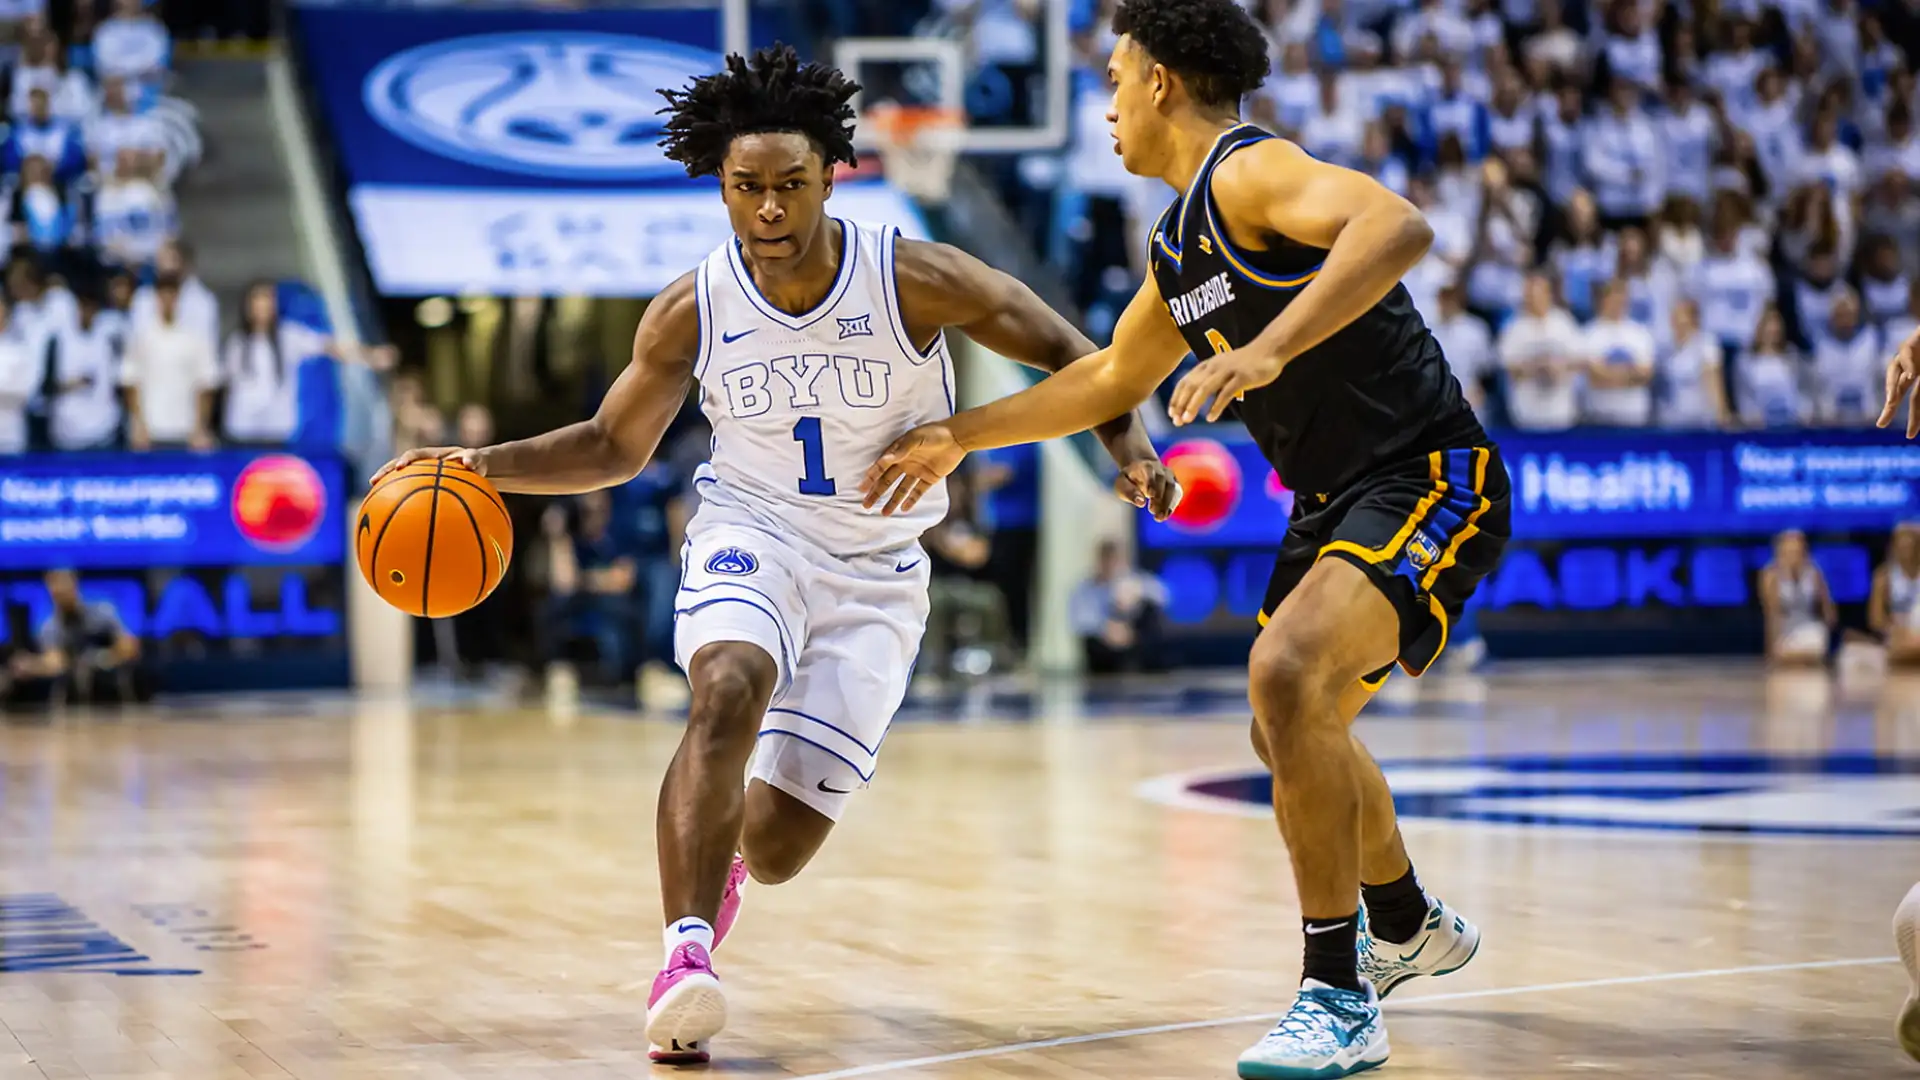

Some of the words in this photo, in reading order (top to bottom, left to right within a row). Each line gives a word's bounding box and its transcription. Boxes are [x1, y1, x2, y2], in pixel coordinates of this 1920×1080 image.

[1168, 271, 1236, 327] RIVERSIDE
[722, 354, 891, 418] BYU
[793, 416, 836, 495] 1
